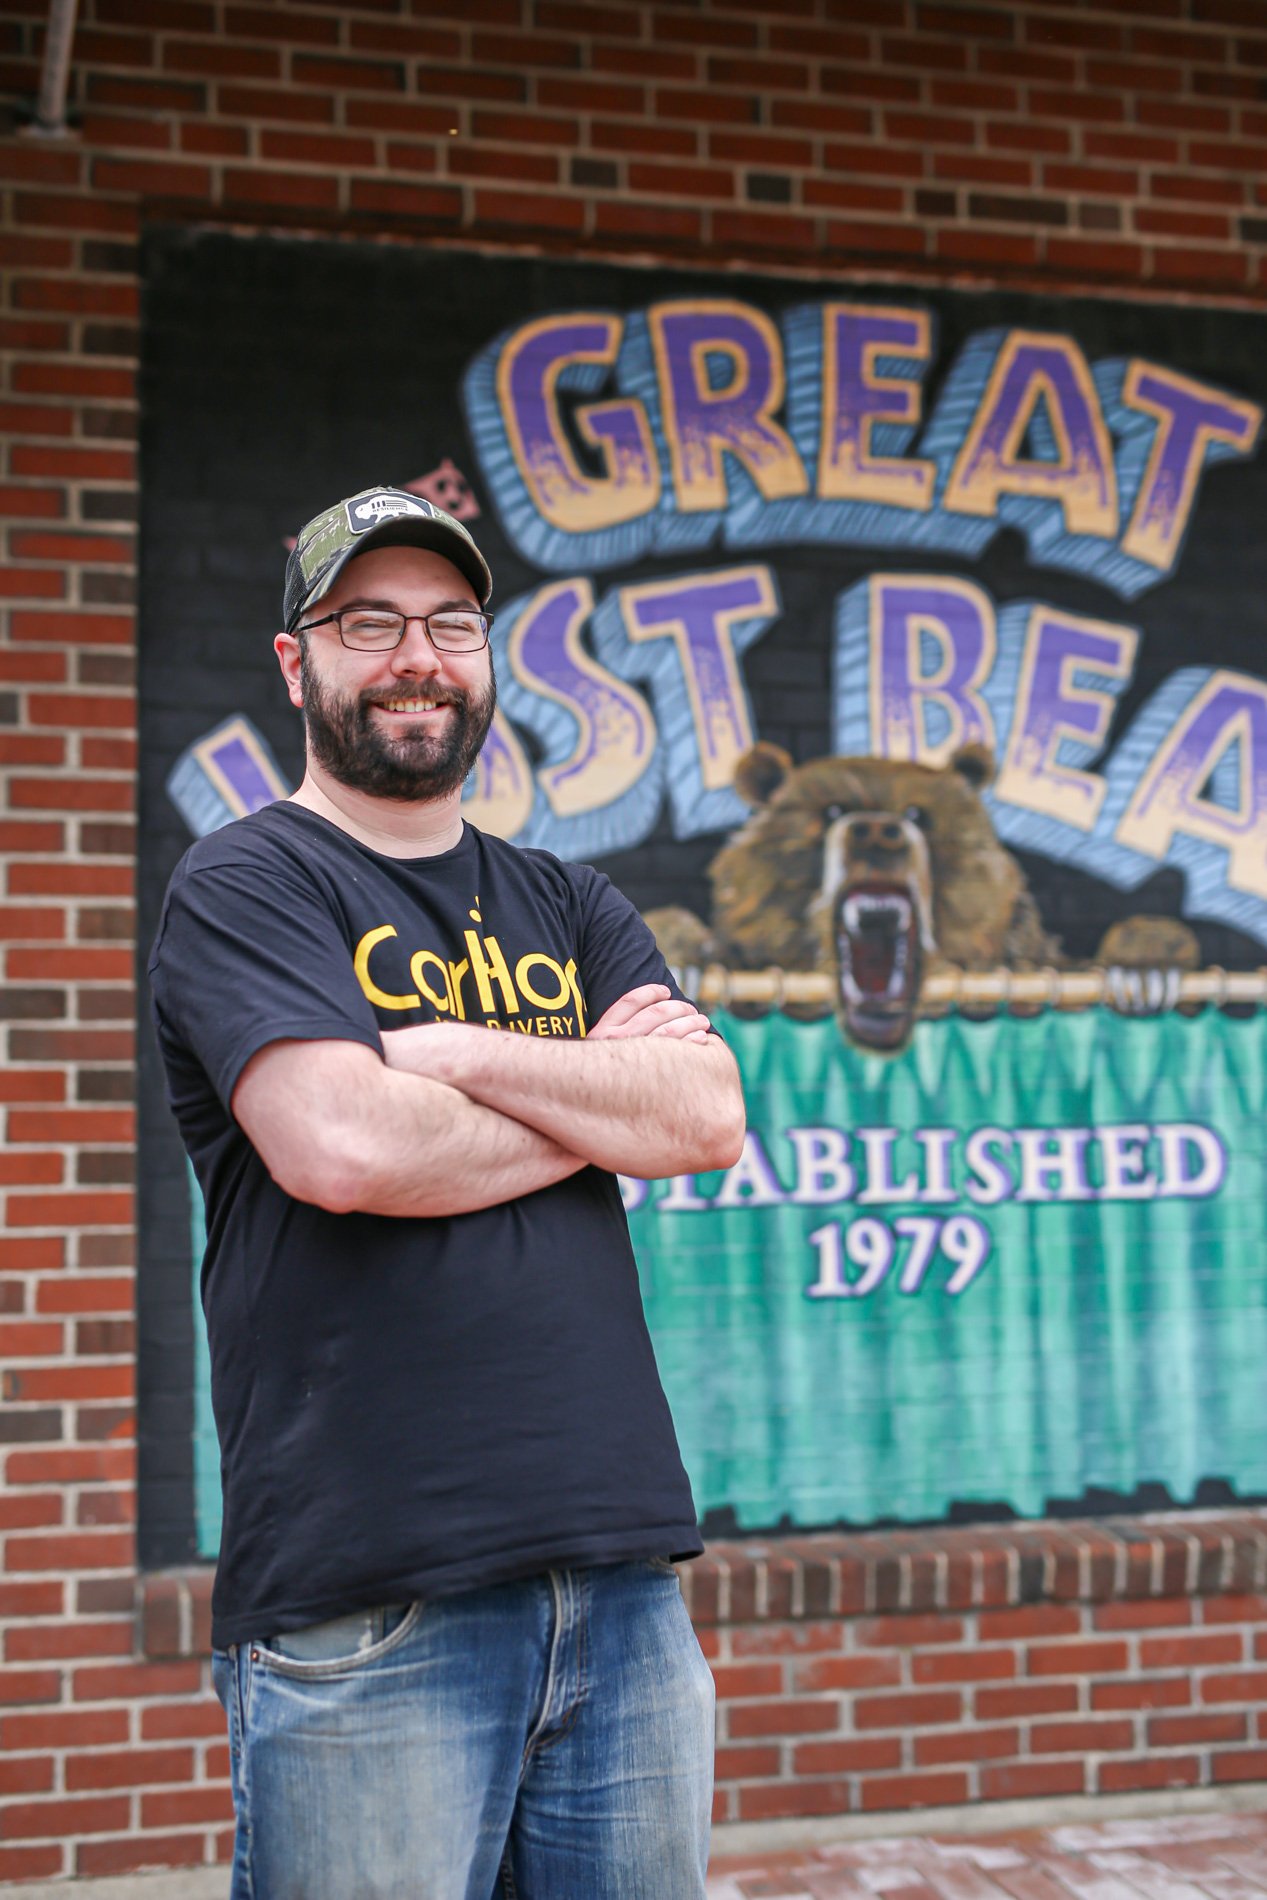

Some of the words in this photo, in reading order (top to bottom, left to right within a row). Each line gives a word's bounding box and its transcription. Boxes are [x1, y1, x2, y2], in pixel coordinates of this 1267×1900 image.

[496, 297, 1265, 571] GREAT
[190, 563, 780, 850] ST
[807, 1214, 990, 1299] 1979
